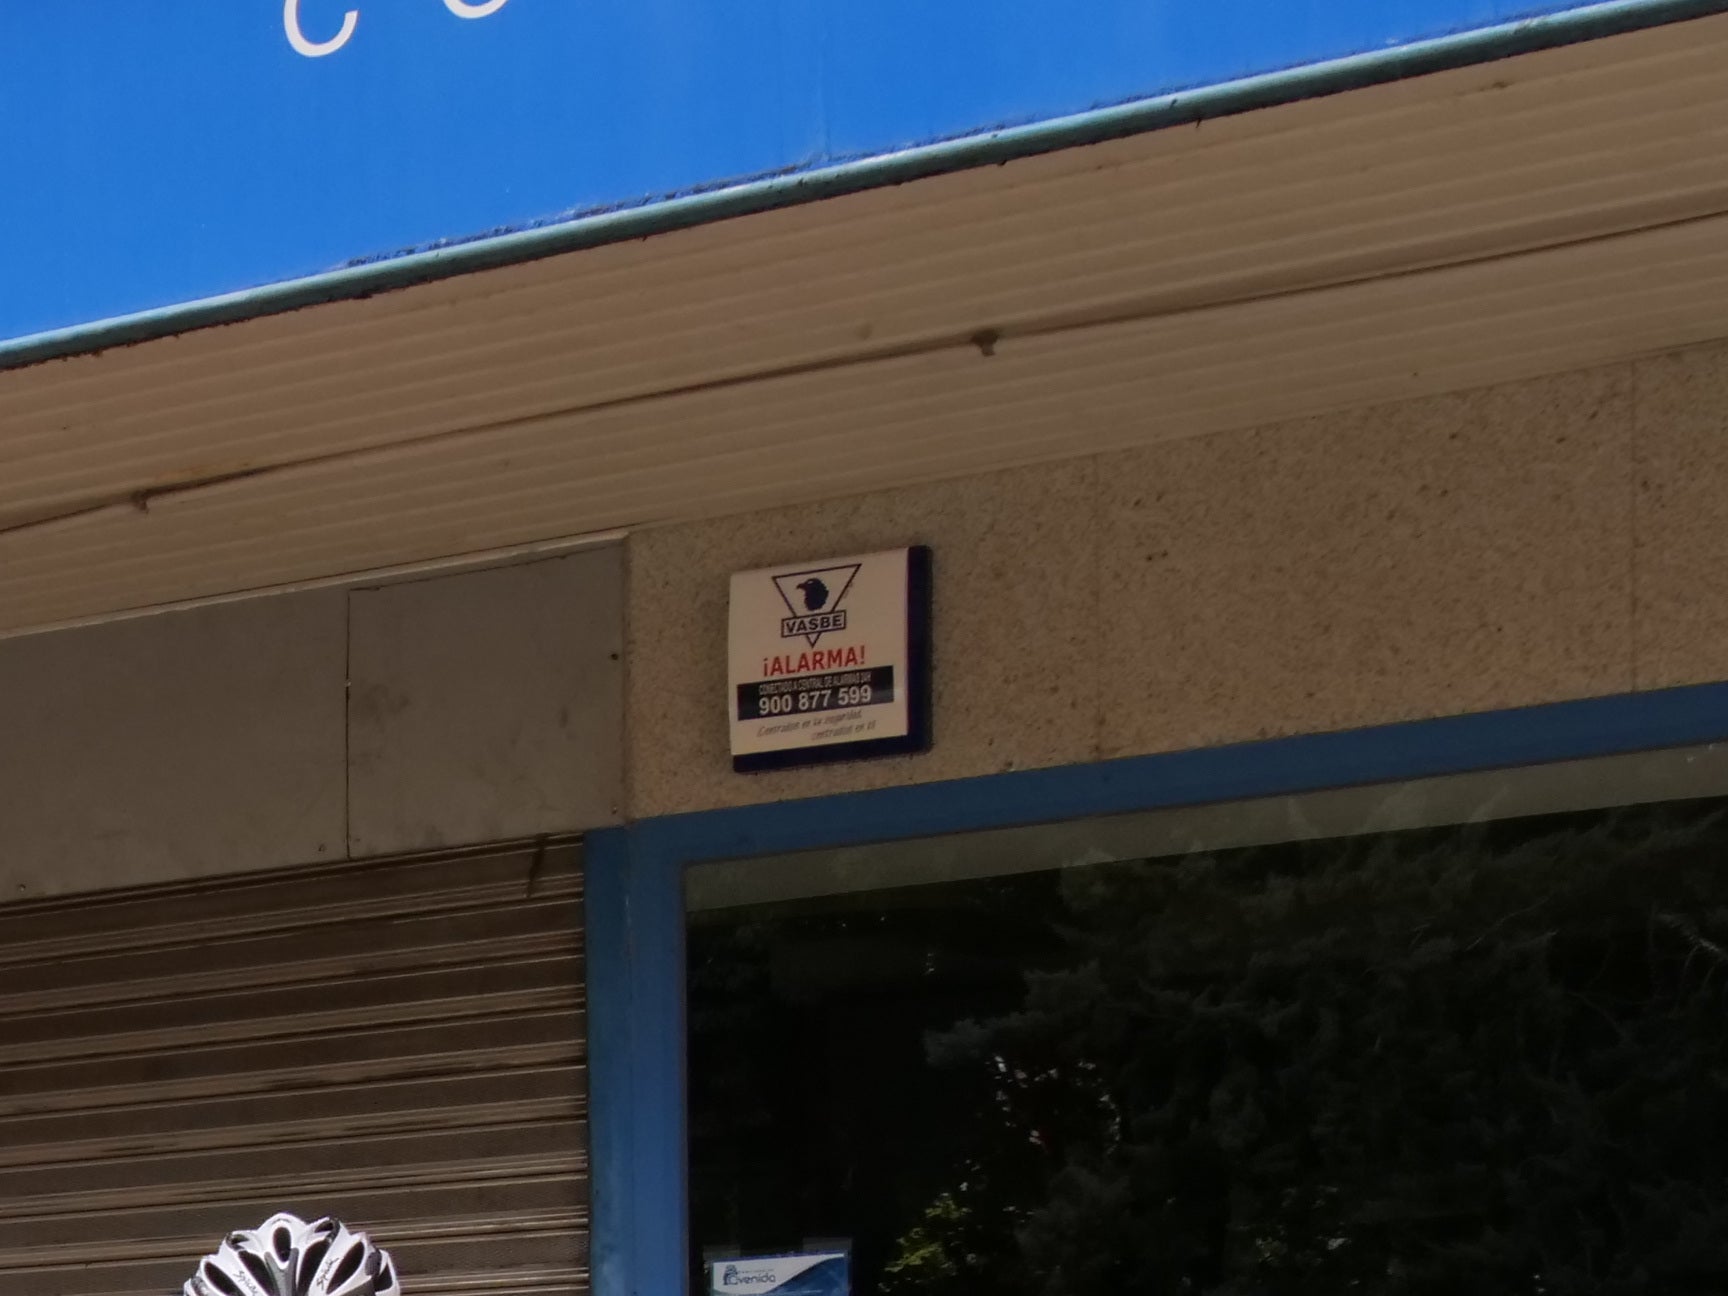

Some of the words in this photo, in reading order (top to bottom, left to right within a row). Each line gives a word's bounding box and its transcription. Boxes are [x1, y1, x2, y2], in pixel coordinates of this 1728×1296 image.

[786, 614, 843, 634] VASBE
[763, 645, 866, 677] ¡ALARMA!
[758, 696, 792, 716] 900
[798, 690, 832, 711] 877
[838, 684, 872, 705] 599
